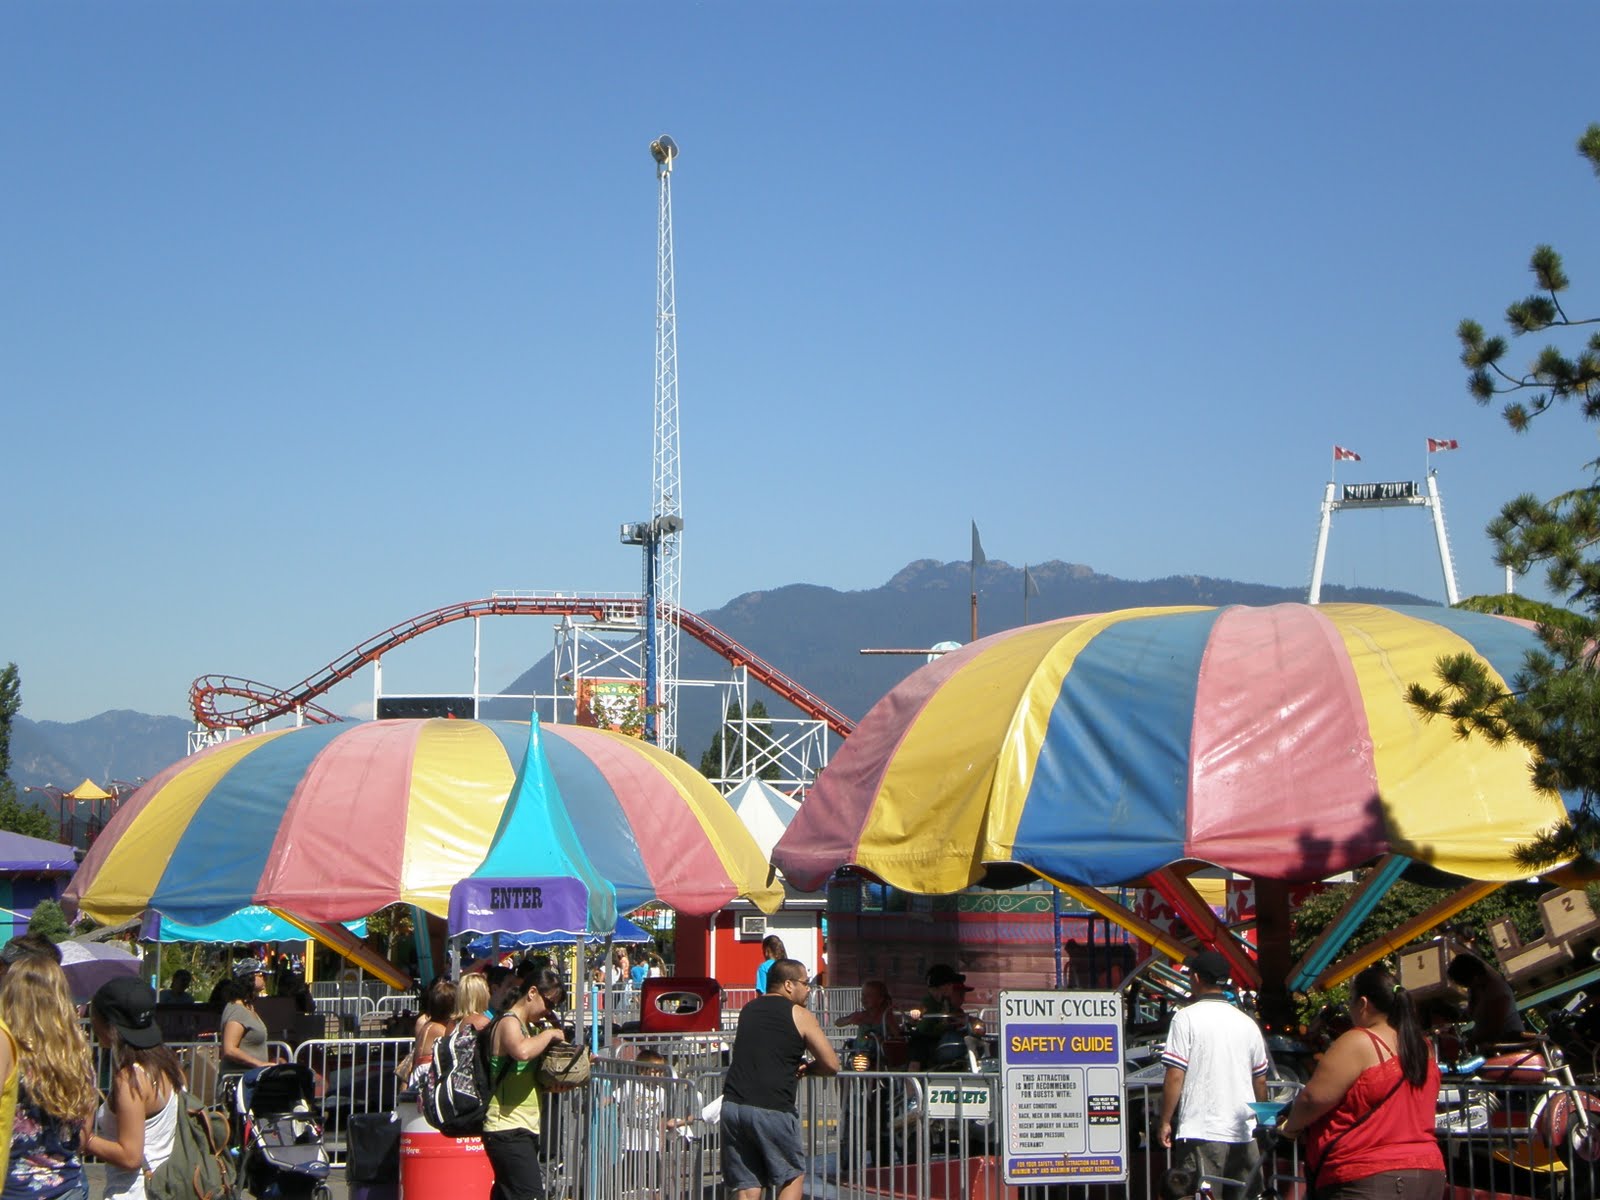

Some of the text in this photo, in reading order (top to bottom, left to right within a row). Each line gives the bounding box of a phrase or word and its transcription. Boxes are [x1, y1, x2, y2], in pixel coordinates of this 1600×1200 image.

[490, 887, 543, 909] ENTER
[1560, 897, 1575, 912] 2
[1417, 955, 1424, 970] 1
[1006, 999, 1116, 1017] STUNT CYCLES
[1012, 1036, 1113, 1052] SAFETY GUIDE
[930, 1090, 939, 1103] 2
